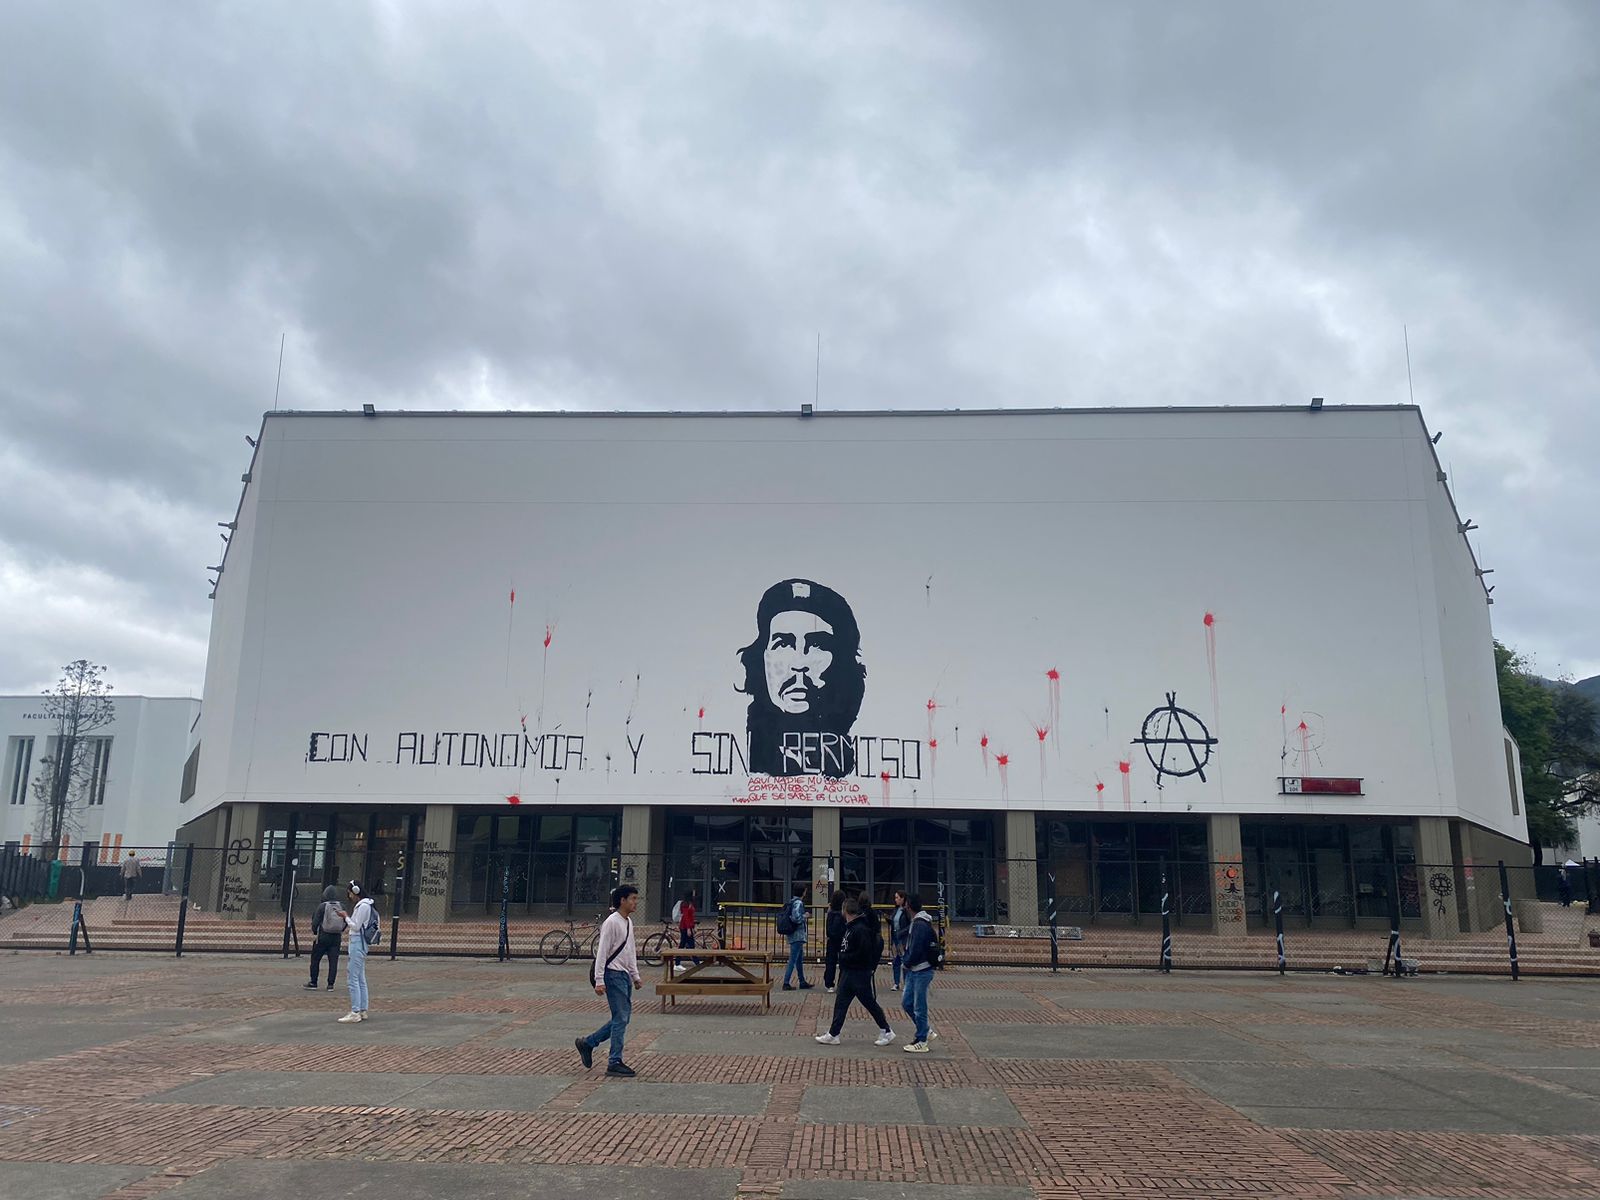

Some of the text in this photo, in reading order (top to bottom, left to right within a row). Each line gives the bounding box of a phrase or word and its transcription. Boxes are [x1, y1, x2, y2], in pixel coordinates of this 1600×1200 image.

[308, 731, 368, 763] CON
[626, 733, 644, 775] Y
[692, 731, 752, 777] SIN
[780, 731, 921, 781] PERMISO
[773, 776, 804, 787] NADIE
[748, 792, 768, 802] QUE
[771, 792, 785, 801] SE
[787, 792, 813, 801] SABE
